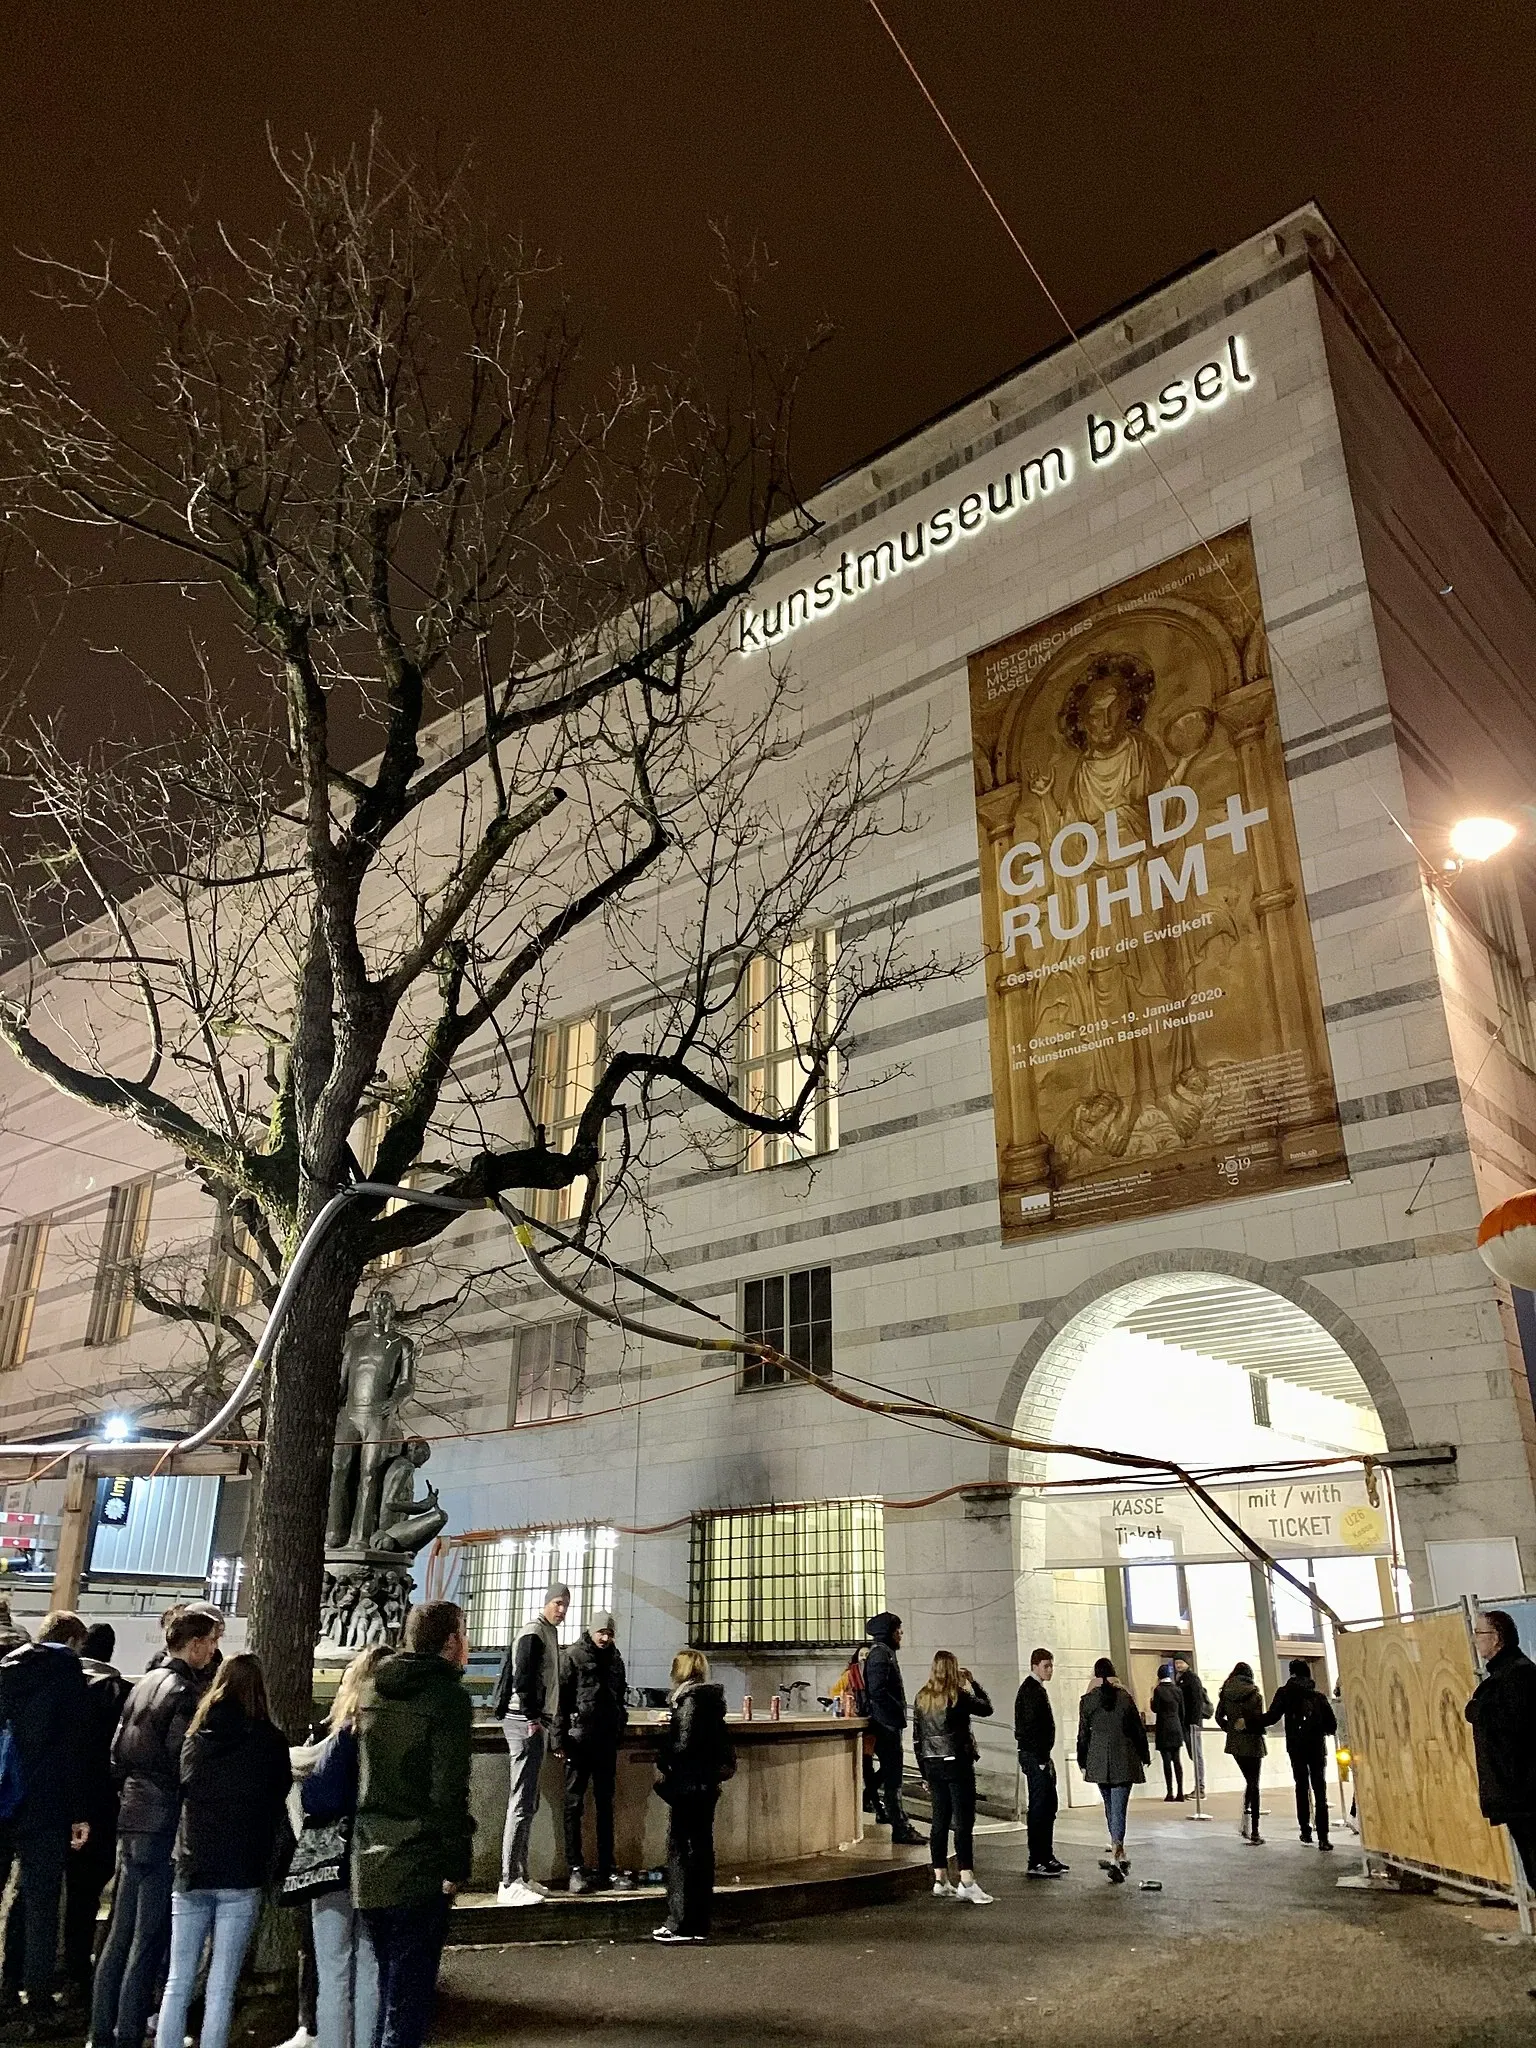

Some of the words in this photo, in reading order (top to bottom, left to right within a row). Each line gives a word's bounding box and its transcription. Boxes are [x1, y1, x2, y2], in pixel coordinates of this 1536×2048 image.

[737, 445, 1067, 653] kunstmuseum
[1087, 335, 1251, 464] basel
[1117, 570, 1196, 615] kunstmuseum
[1198, 554, 1231, 578] basel
[985, 618, 1093, 676] HISTORISCHES
[986, 651, 1052, 689] MUSEUM
[987, 673, 1033, 701] BASEL
[1000, 785, 1200, 896] GOLD
[1002, 843, 1210, 958] RUHM
[1006, 954, 1087, 988] Geschenke
[1089, 944, 1111, 963] für
[1114, 935, 1139, 954] die
[1142, 912, 1214, 946] Ewigkeit
[1011, 1041, 1027, 1056] 11.
[1028, 1027, 1077, 1052] Oktober
[1078, 1018, 1110, 1039] 2019
[1120, 1010, 1141, 1024] 19.
[1142, 998, 1187, 1020] Januar
[1190, 986, 1223, 1007] 2020
[1012, 1057, 1026, 1071] im
[1028, 1035, 1115, 1067] Kunstmuseum
[1117, 1025, 1153, 1044] Basel
[1162, 1007, 1214, 1031] Neubau
[1112, 1497, 1164, 1517] KASSE
[1248, 1486, 1278, 1508] mit
[1299, 1484, 1342, 1505] with
[1344, 1509, 1366, 1527] U26
[1267, 1515, 1332, 1538] TICKET
